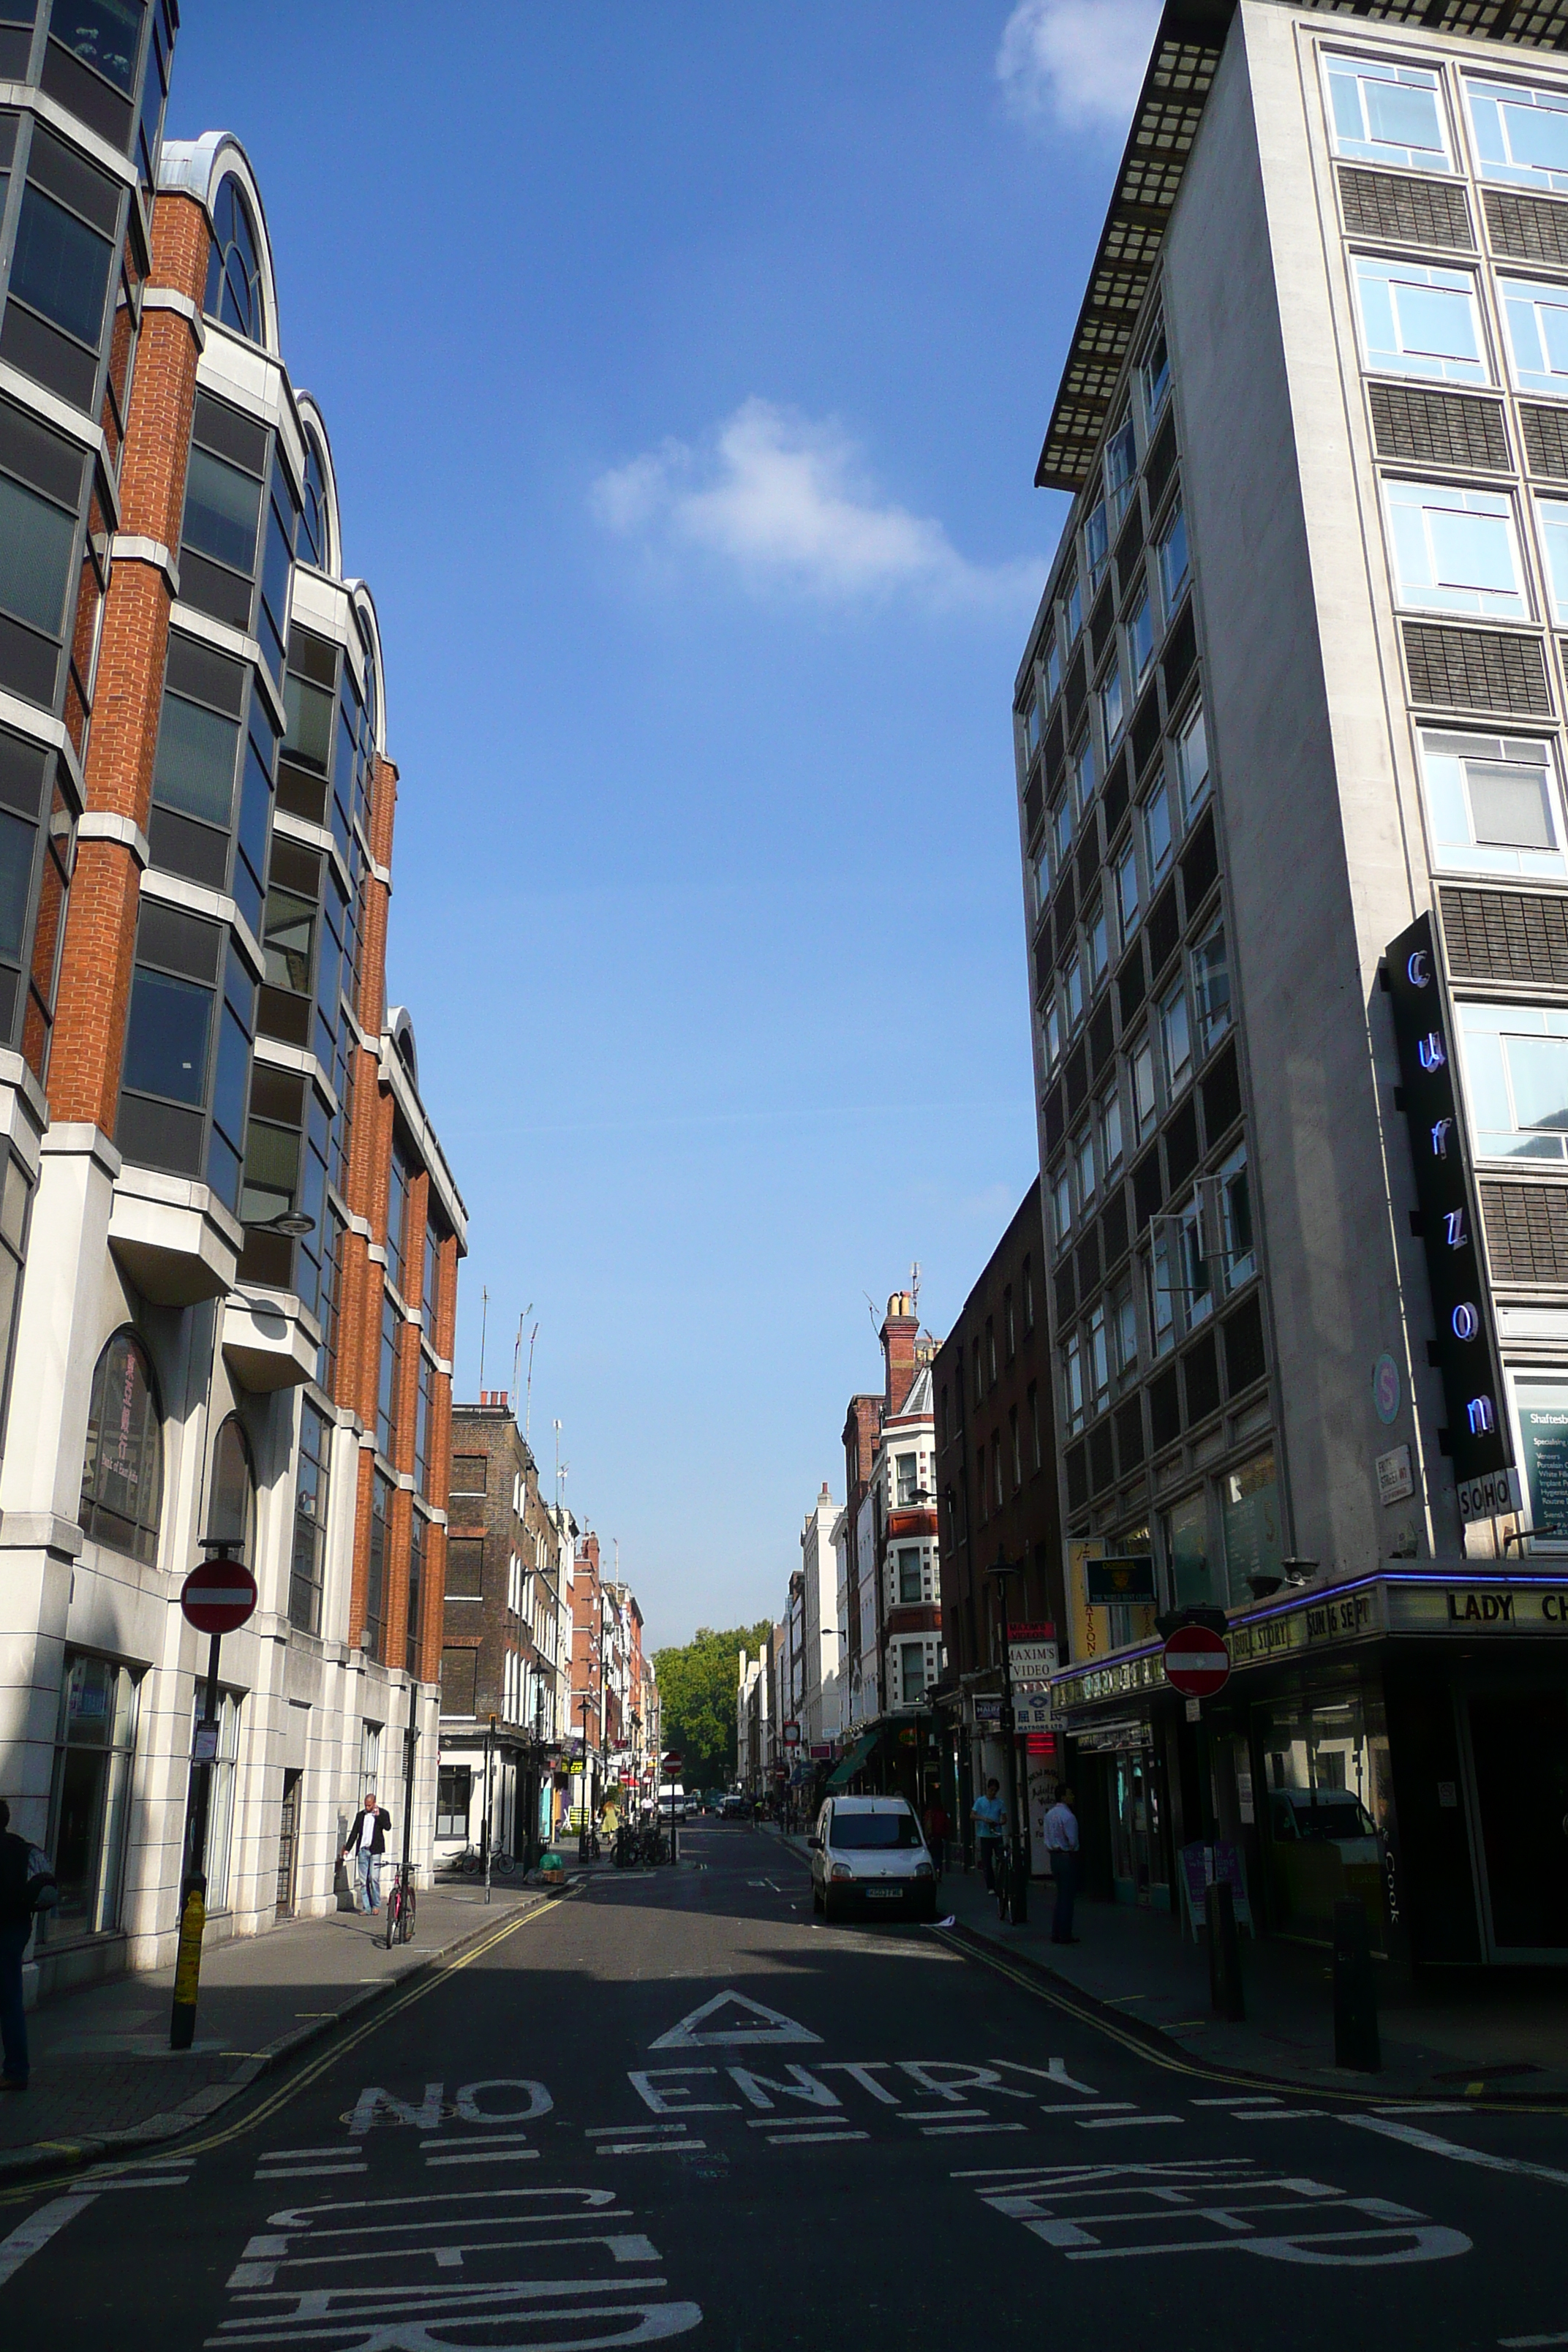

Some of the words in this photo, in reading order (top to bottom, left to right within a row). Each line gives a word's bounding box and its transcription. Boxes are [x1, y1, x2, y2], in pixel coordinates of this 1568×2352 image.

[1408, 950, 1495, 1439] Curzon
[1530, 1413, 1568, 1425] Shaftesb
[1534, 1438, 1567, 1447] Specialising
[1536, 1452, 1561, 1460] Veneers
[102, 1452, 113, 1470] Bank
[1537, 1461, 1564, 1469] Porcelain
[1460, 1480, 1508, 1515] SOHO
[1449, 1594, 1512, 1621] LADY
[1257, 1621, 1287, 1650] STORY
[1307, 1610, 1325, 1636] SUN
[1340, 1597, 1370, 1628] SEPT
[1013, 1665, 1049, 1676] VIDEO
[1385, 1851, 1400, 1925] Cook
[348, 2079, 554, 2136] NO
[627, 2057, 1100, 2114] ENTRY
[949, 2157, 1474, 2266] KEEP
[201, 2187, 704, 2352] CLEAR
